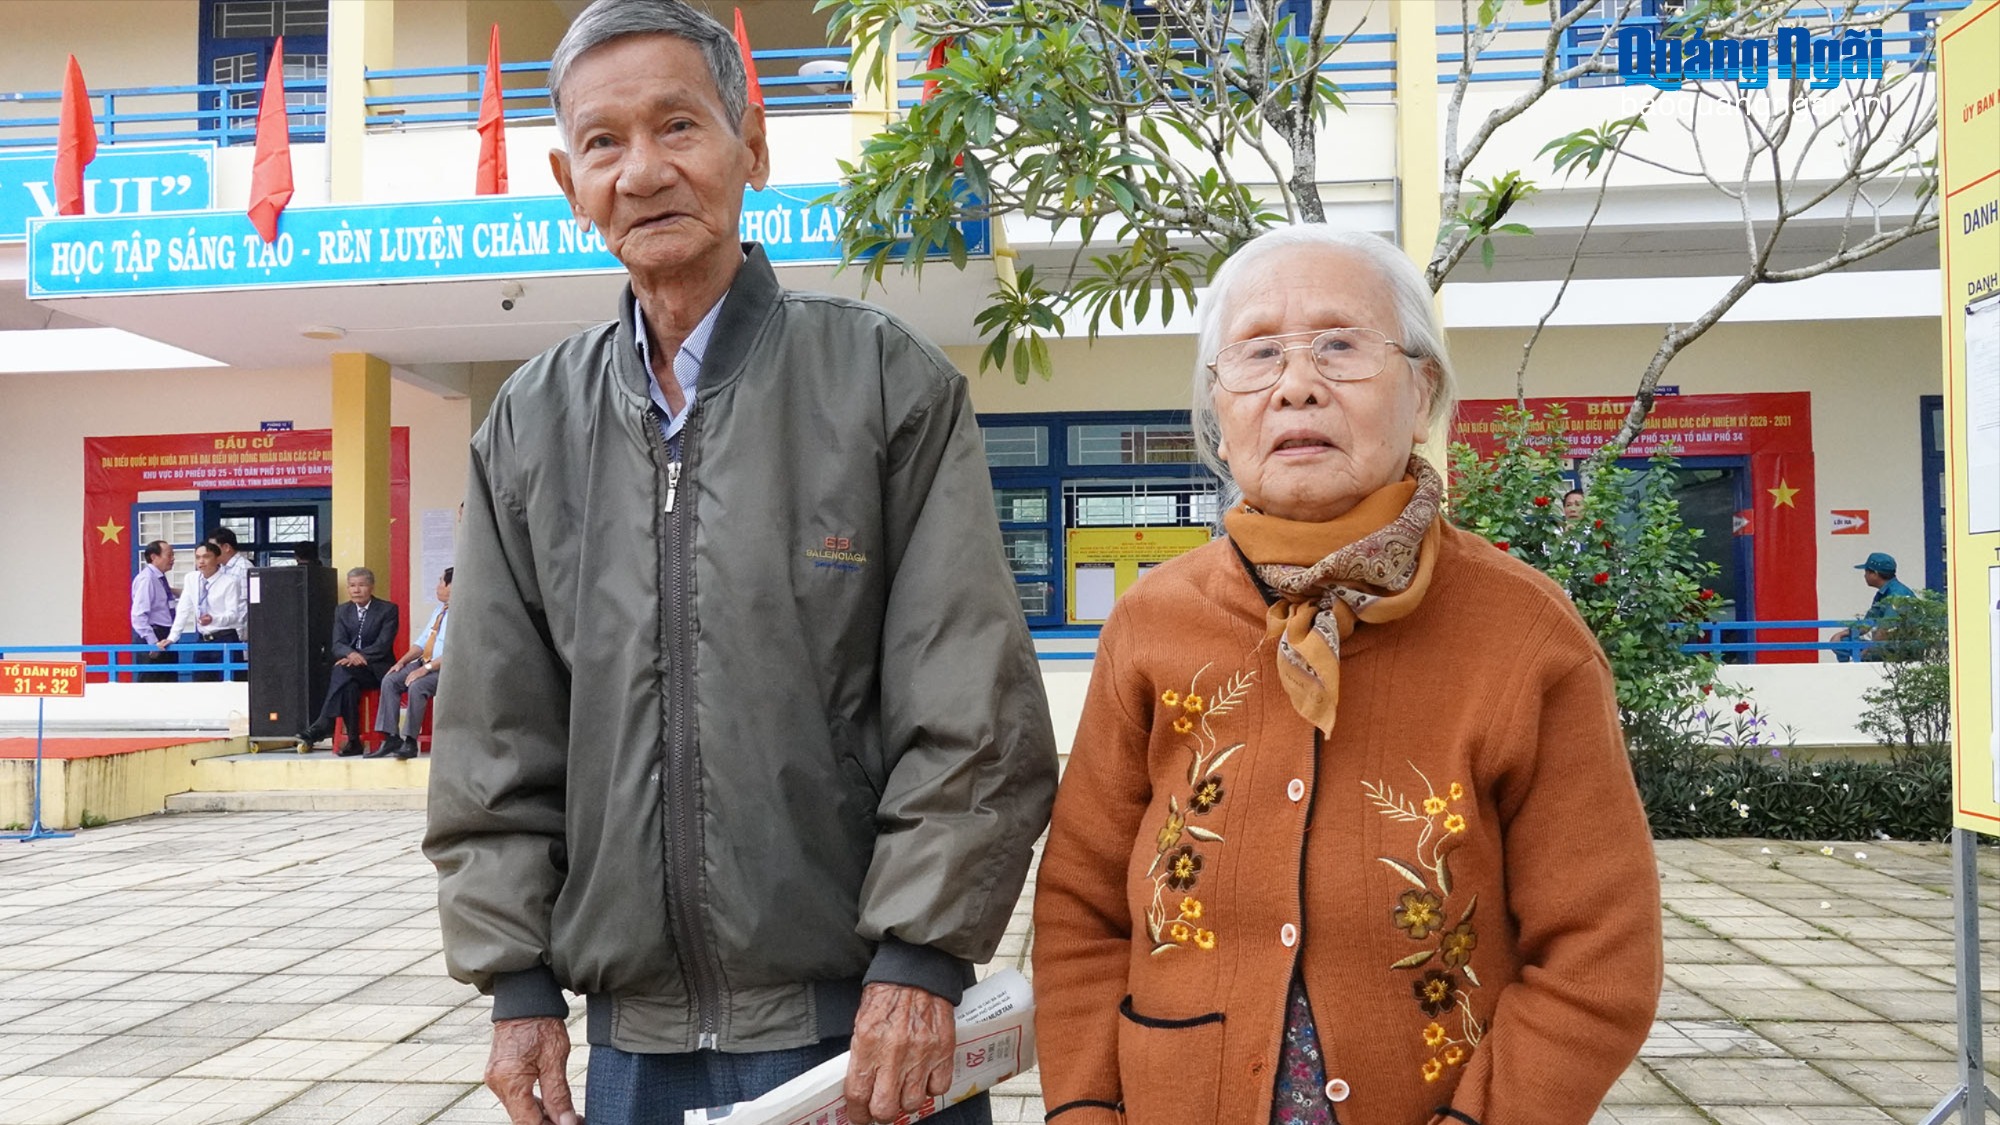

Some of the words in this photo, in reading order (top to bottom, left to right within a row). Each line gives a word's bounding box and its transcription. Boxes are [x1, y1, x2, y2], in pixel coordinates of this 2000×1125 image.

[1977, 92, 1995, 115] BAN
[1963, 199, 1999, 235] DANH
[50, 240, 104, 284] HỌC
[112, 230, 161, 282] TẬP
[168, 227, 236, 272] SÁNG
[243, 232, 294, 277] TẠO
[318, 219, 373, 265] RÈN
[379, 215, 464, 269] LUYỆN
[472, 211, 550, 259] CHĂM
[557, 219, 609, 254] NGO
[1967, 272, 1998, 296] DANH
[1750, 416, 1768, 427] 2026
[1774, 416, 1791, 426] 2031
[1733, 433, 1743, 441] 34
[218, 469, 227, 477] 25
[275, 467, 285, 475] 31
[324, 466, 333, 474] PH
[3, 663, 20, 677] TỔ
[23, 665, 49, 677] DÂN
[52, 664, 78, 677] PHỐ
[14, 678, 31, 694] 31
[50, 678, 69, 694] 32
